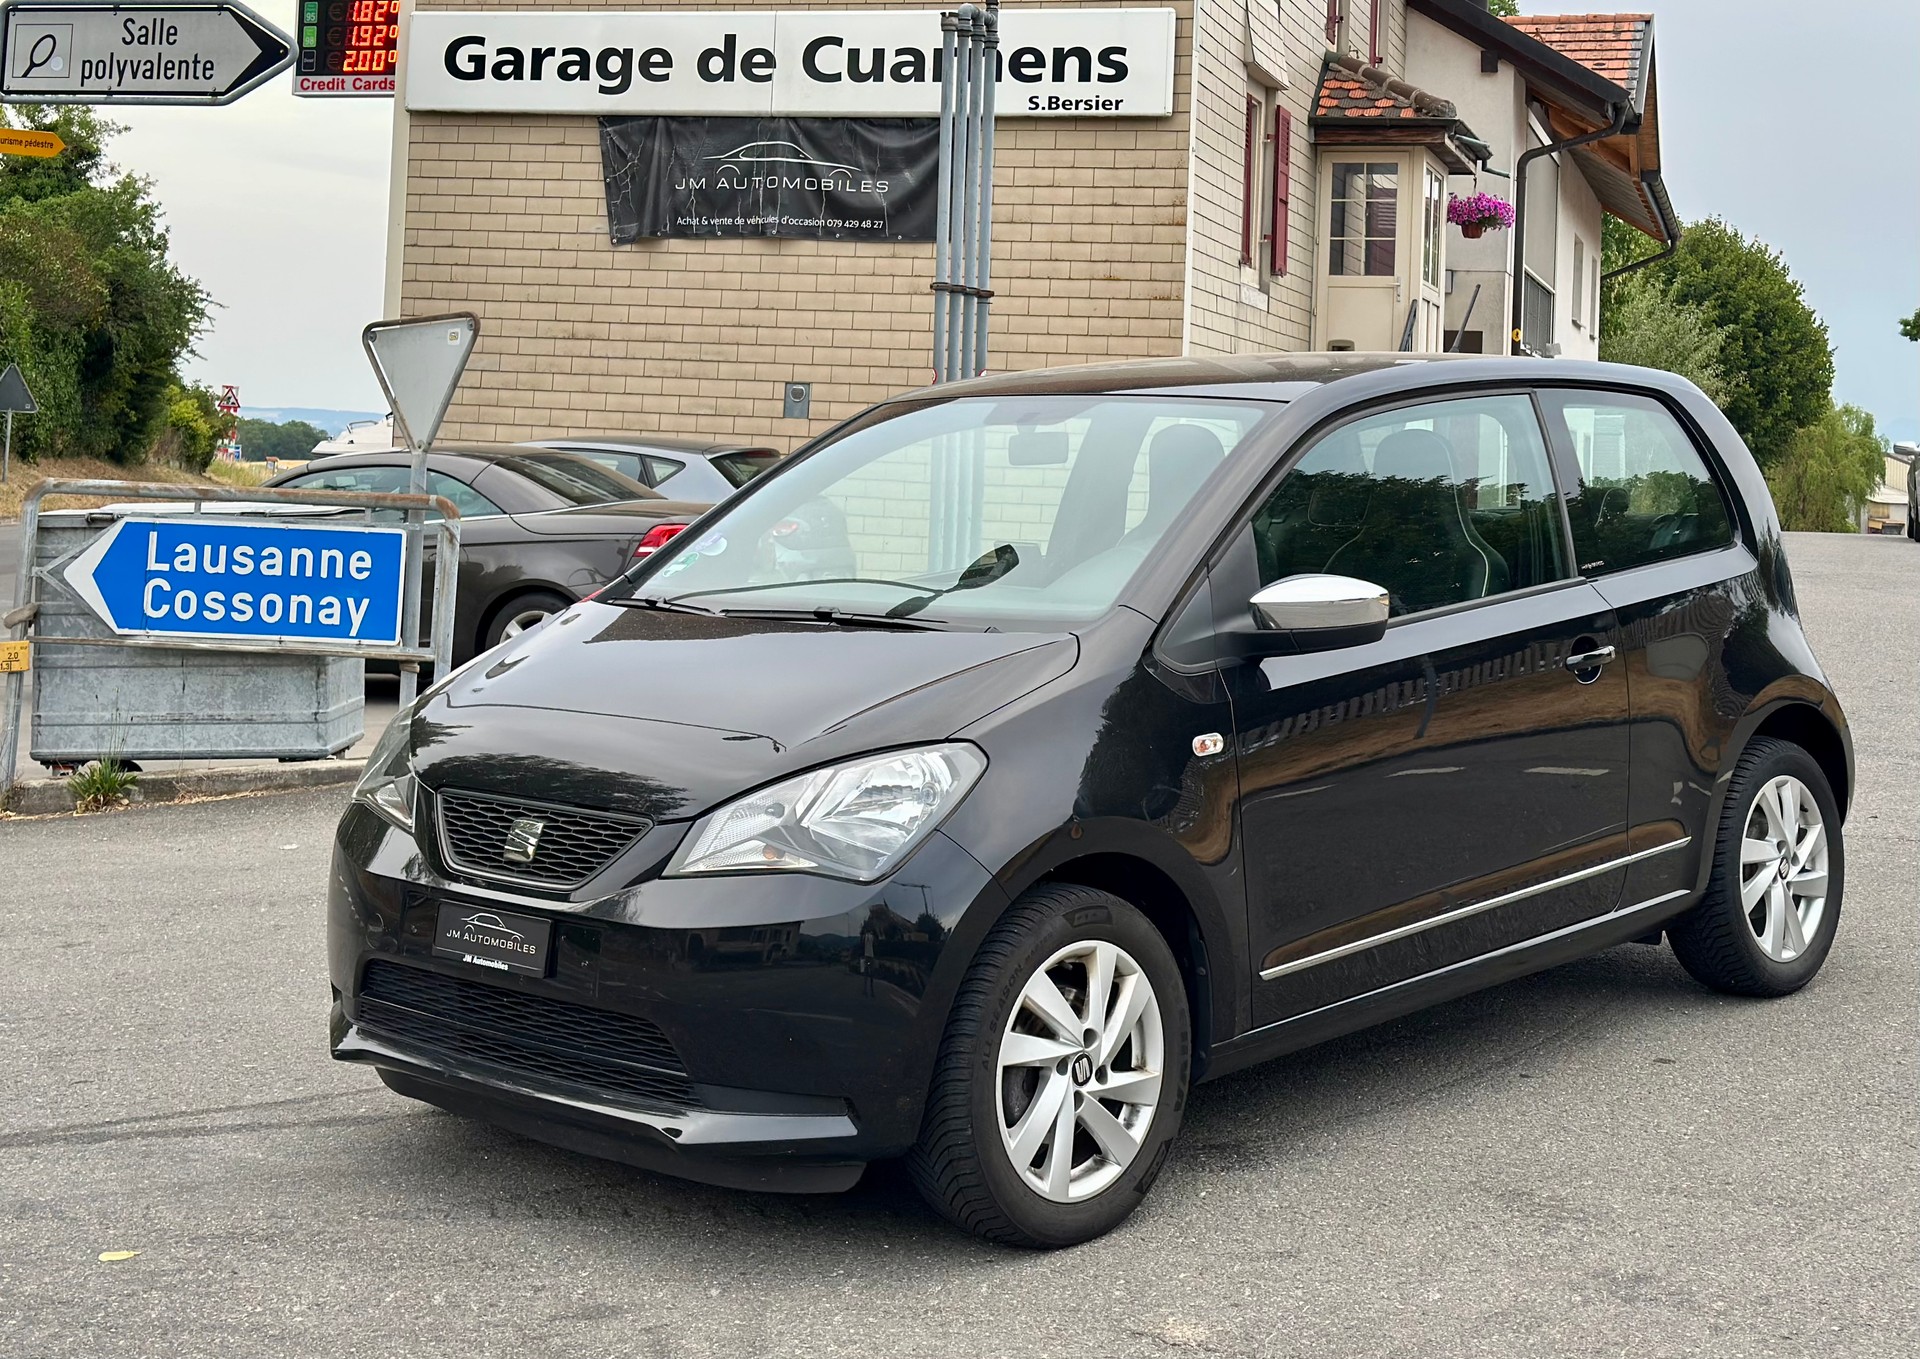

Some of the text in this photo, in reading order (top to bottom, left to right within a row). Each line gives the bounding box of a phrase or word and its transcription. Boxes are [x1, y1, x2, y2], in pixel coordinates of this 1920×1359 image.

[306, 12, 316, 21] 95
[121, 17, 178, 46] Salle
[80, 51, 215, 88] polyvalente
[444, 35, 673, 95] Garage
[696, 33, 777, 83] de
[300, 77, 395, 91] Credit Cards
[1028, 94, 1124, 111] S.Bersier
[24, 139, 54, 149] pédestre
[675, 176, 889, 193] JM AUTOMOBILES
[676, 216, 700, 226] Achat
[701, 216, 708, 225] &
[710, 217, 733, 225] vente
[734, 216, 745, 225] de
[781, 215, 825, 227] d'occasion
[826, 219, 842, 228] 079
[843, 220, 859, 229] 429
[860, 220, 872, 229] 48
[873, 220, 884, 229] 27
[145, 530, 373, 581] Lausanne
[142, 577, 371, 638] Cossonay
[446, 929, 537, 954] JM AUTOMOBILES
[462, 953, 509, 971] JM Automobiles
